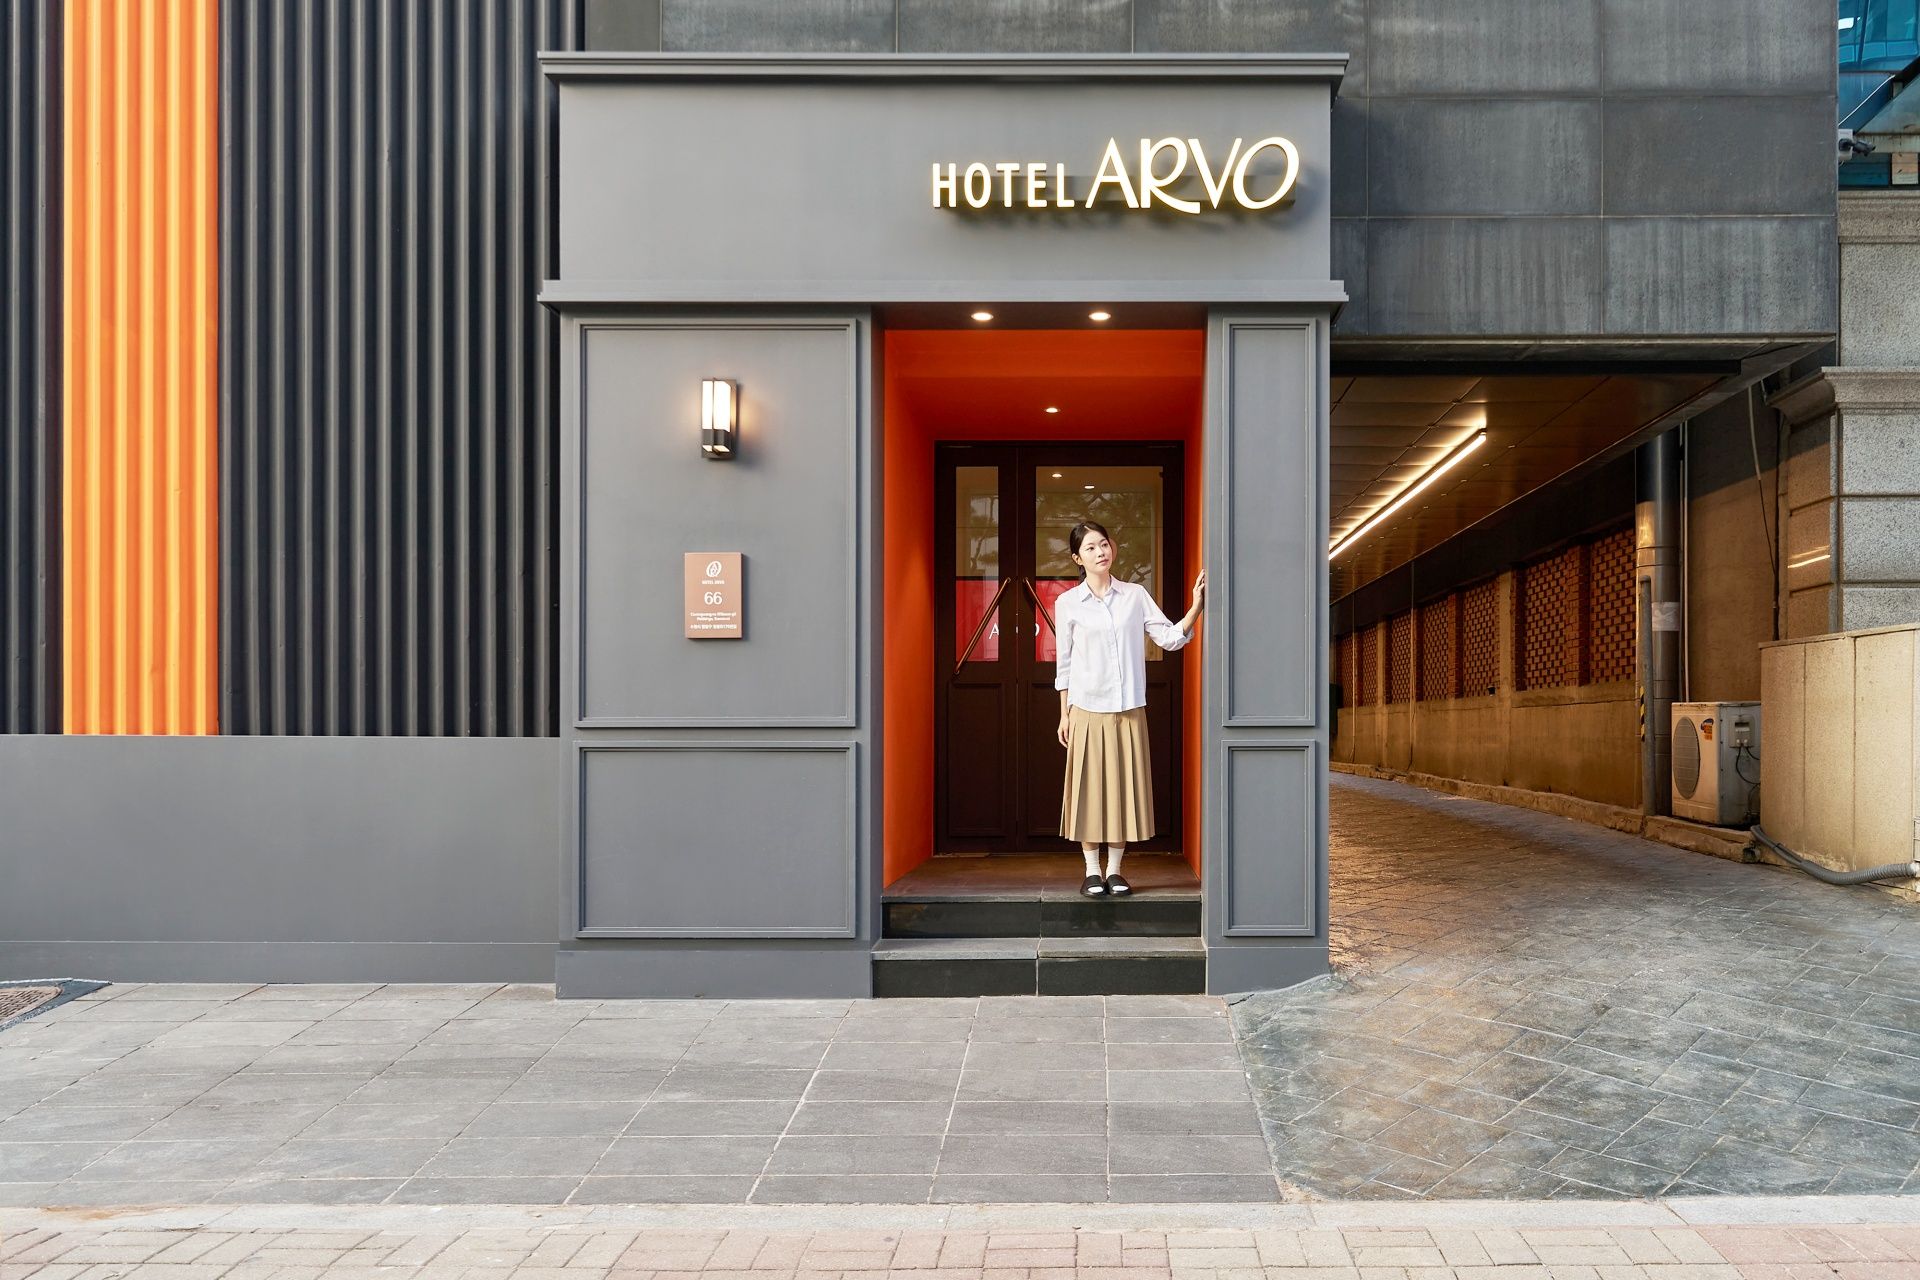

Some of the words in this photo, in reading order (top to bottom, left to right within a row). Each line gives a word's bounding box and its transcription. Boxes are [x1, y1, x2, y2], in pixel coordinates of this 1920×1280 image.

[932, 162, 1076, 208] HOTEL
[1085, 136, 1300, 214] ARVO
[704, 591, 723, 605] 66
